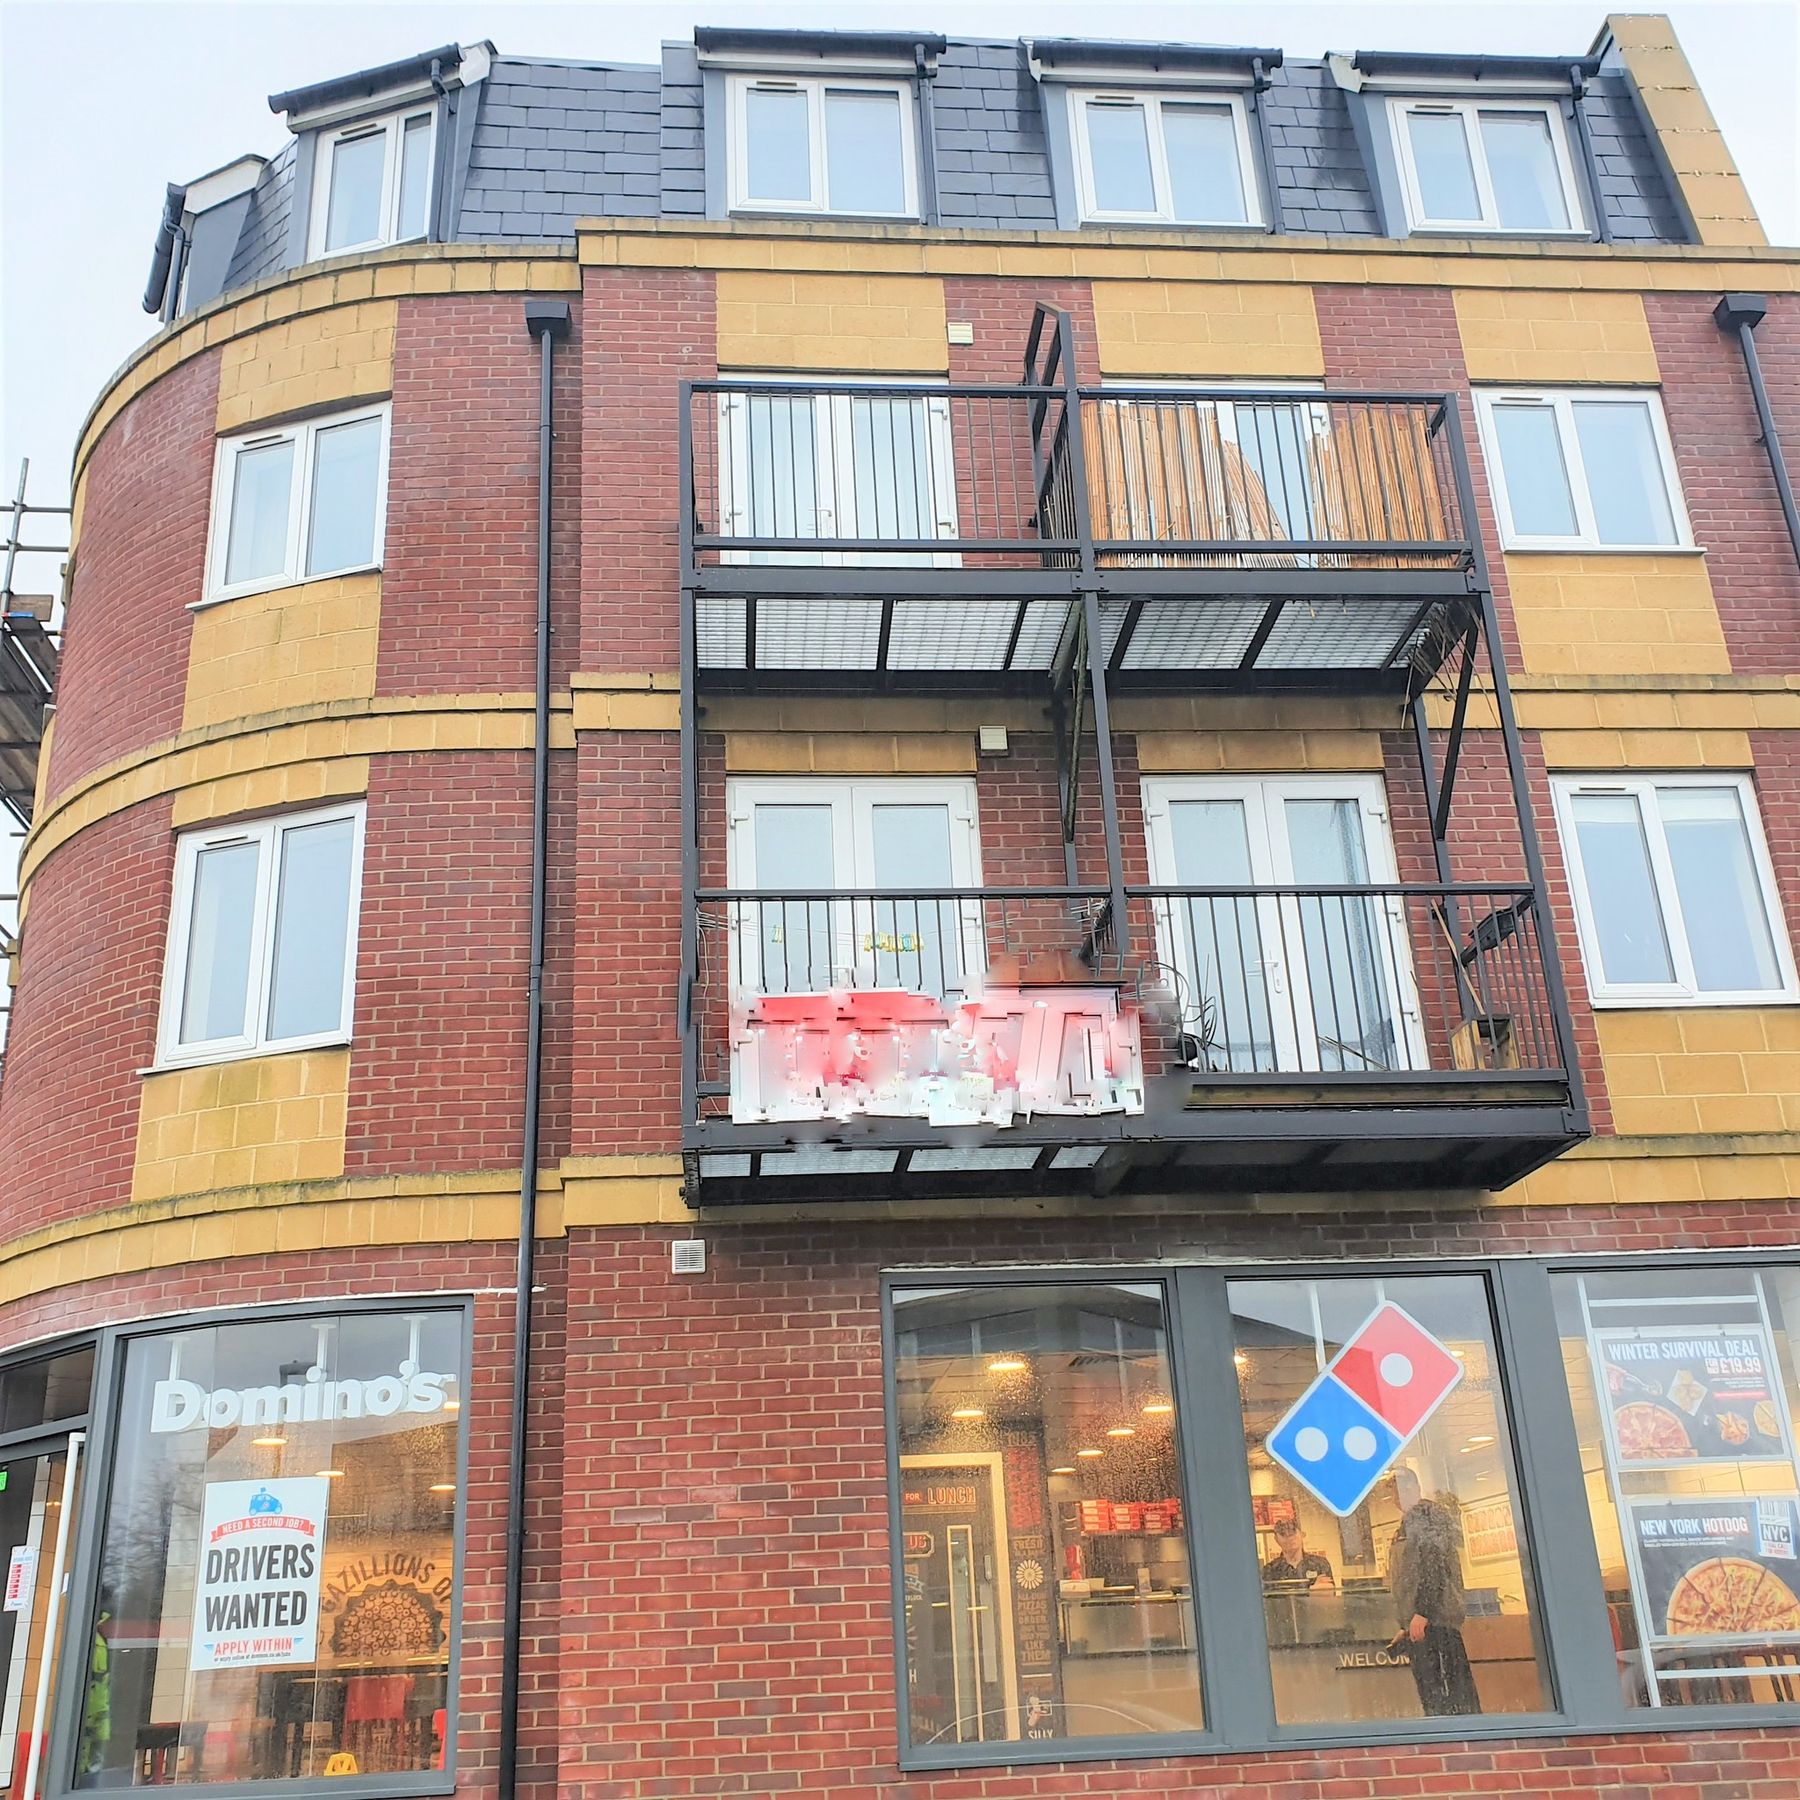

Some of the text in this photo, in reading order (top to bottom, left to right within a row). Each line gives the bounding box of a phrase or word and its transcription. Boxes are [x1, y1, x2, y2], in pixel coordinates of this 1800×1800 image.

[1608, 1339, 1758, 1360] WINTER SURVIVAL DEAL
[1720, 1356, 1761, 1374] £19.99
[150, 1359, 444, 1433] Domino's
[927, 1486, 976, 1504] LUNCH
[221, 1517, 305, 1534] NEED A SECOND JOB?
[1639, 1516, 1748, 1535] NEW YORK HOTDOG
[1762, 1523, 1788, 1542] NYC
[205, 1543, 315, 1584] DRIVERS
[321, 1553, 435, 1613] GAZILLIONS
[205, 1590, 308, 1632] WANTED
[214, 1637, 293, 1656] APPLY WITHIN
